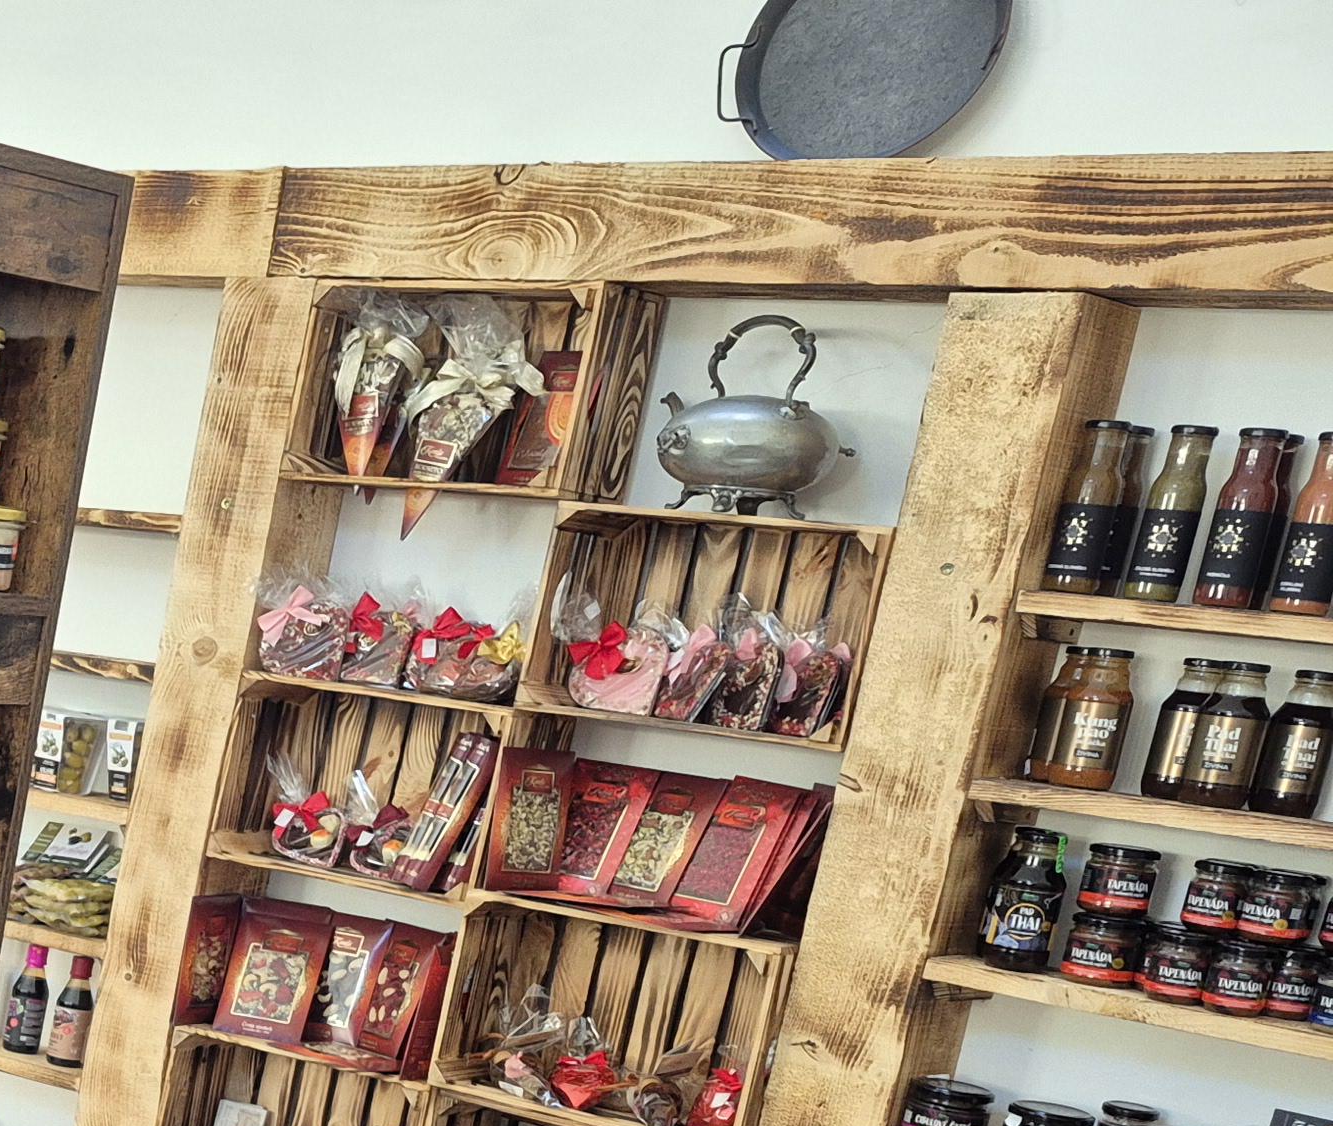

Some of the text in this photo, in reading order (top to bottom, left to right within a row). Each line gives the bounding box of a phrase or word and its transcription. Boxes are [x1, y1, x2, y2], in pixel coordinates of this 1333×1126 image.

[1074, 711, 1118, 732] Kung
[1207, 724, 1242, 740] Pad
[1205, 738, 1239, 753] Thai
[1286, 735, 1321, 751] Pad
[1283, 747, 1317, 763] Thai
[1187, 893, 1229, 911] TAPENÁDA
[1241, 902, 1280, 920] TAPENÁDA
[1010, 915, 1041, 931] THAI
[1071, 947, 1113, 963] TAPENÁDA
[1158, 964, 1202, 982] TAPENÁDA
[1218, 977, 1263, 993] TAPENÁDA
